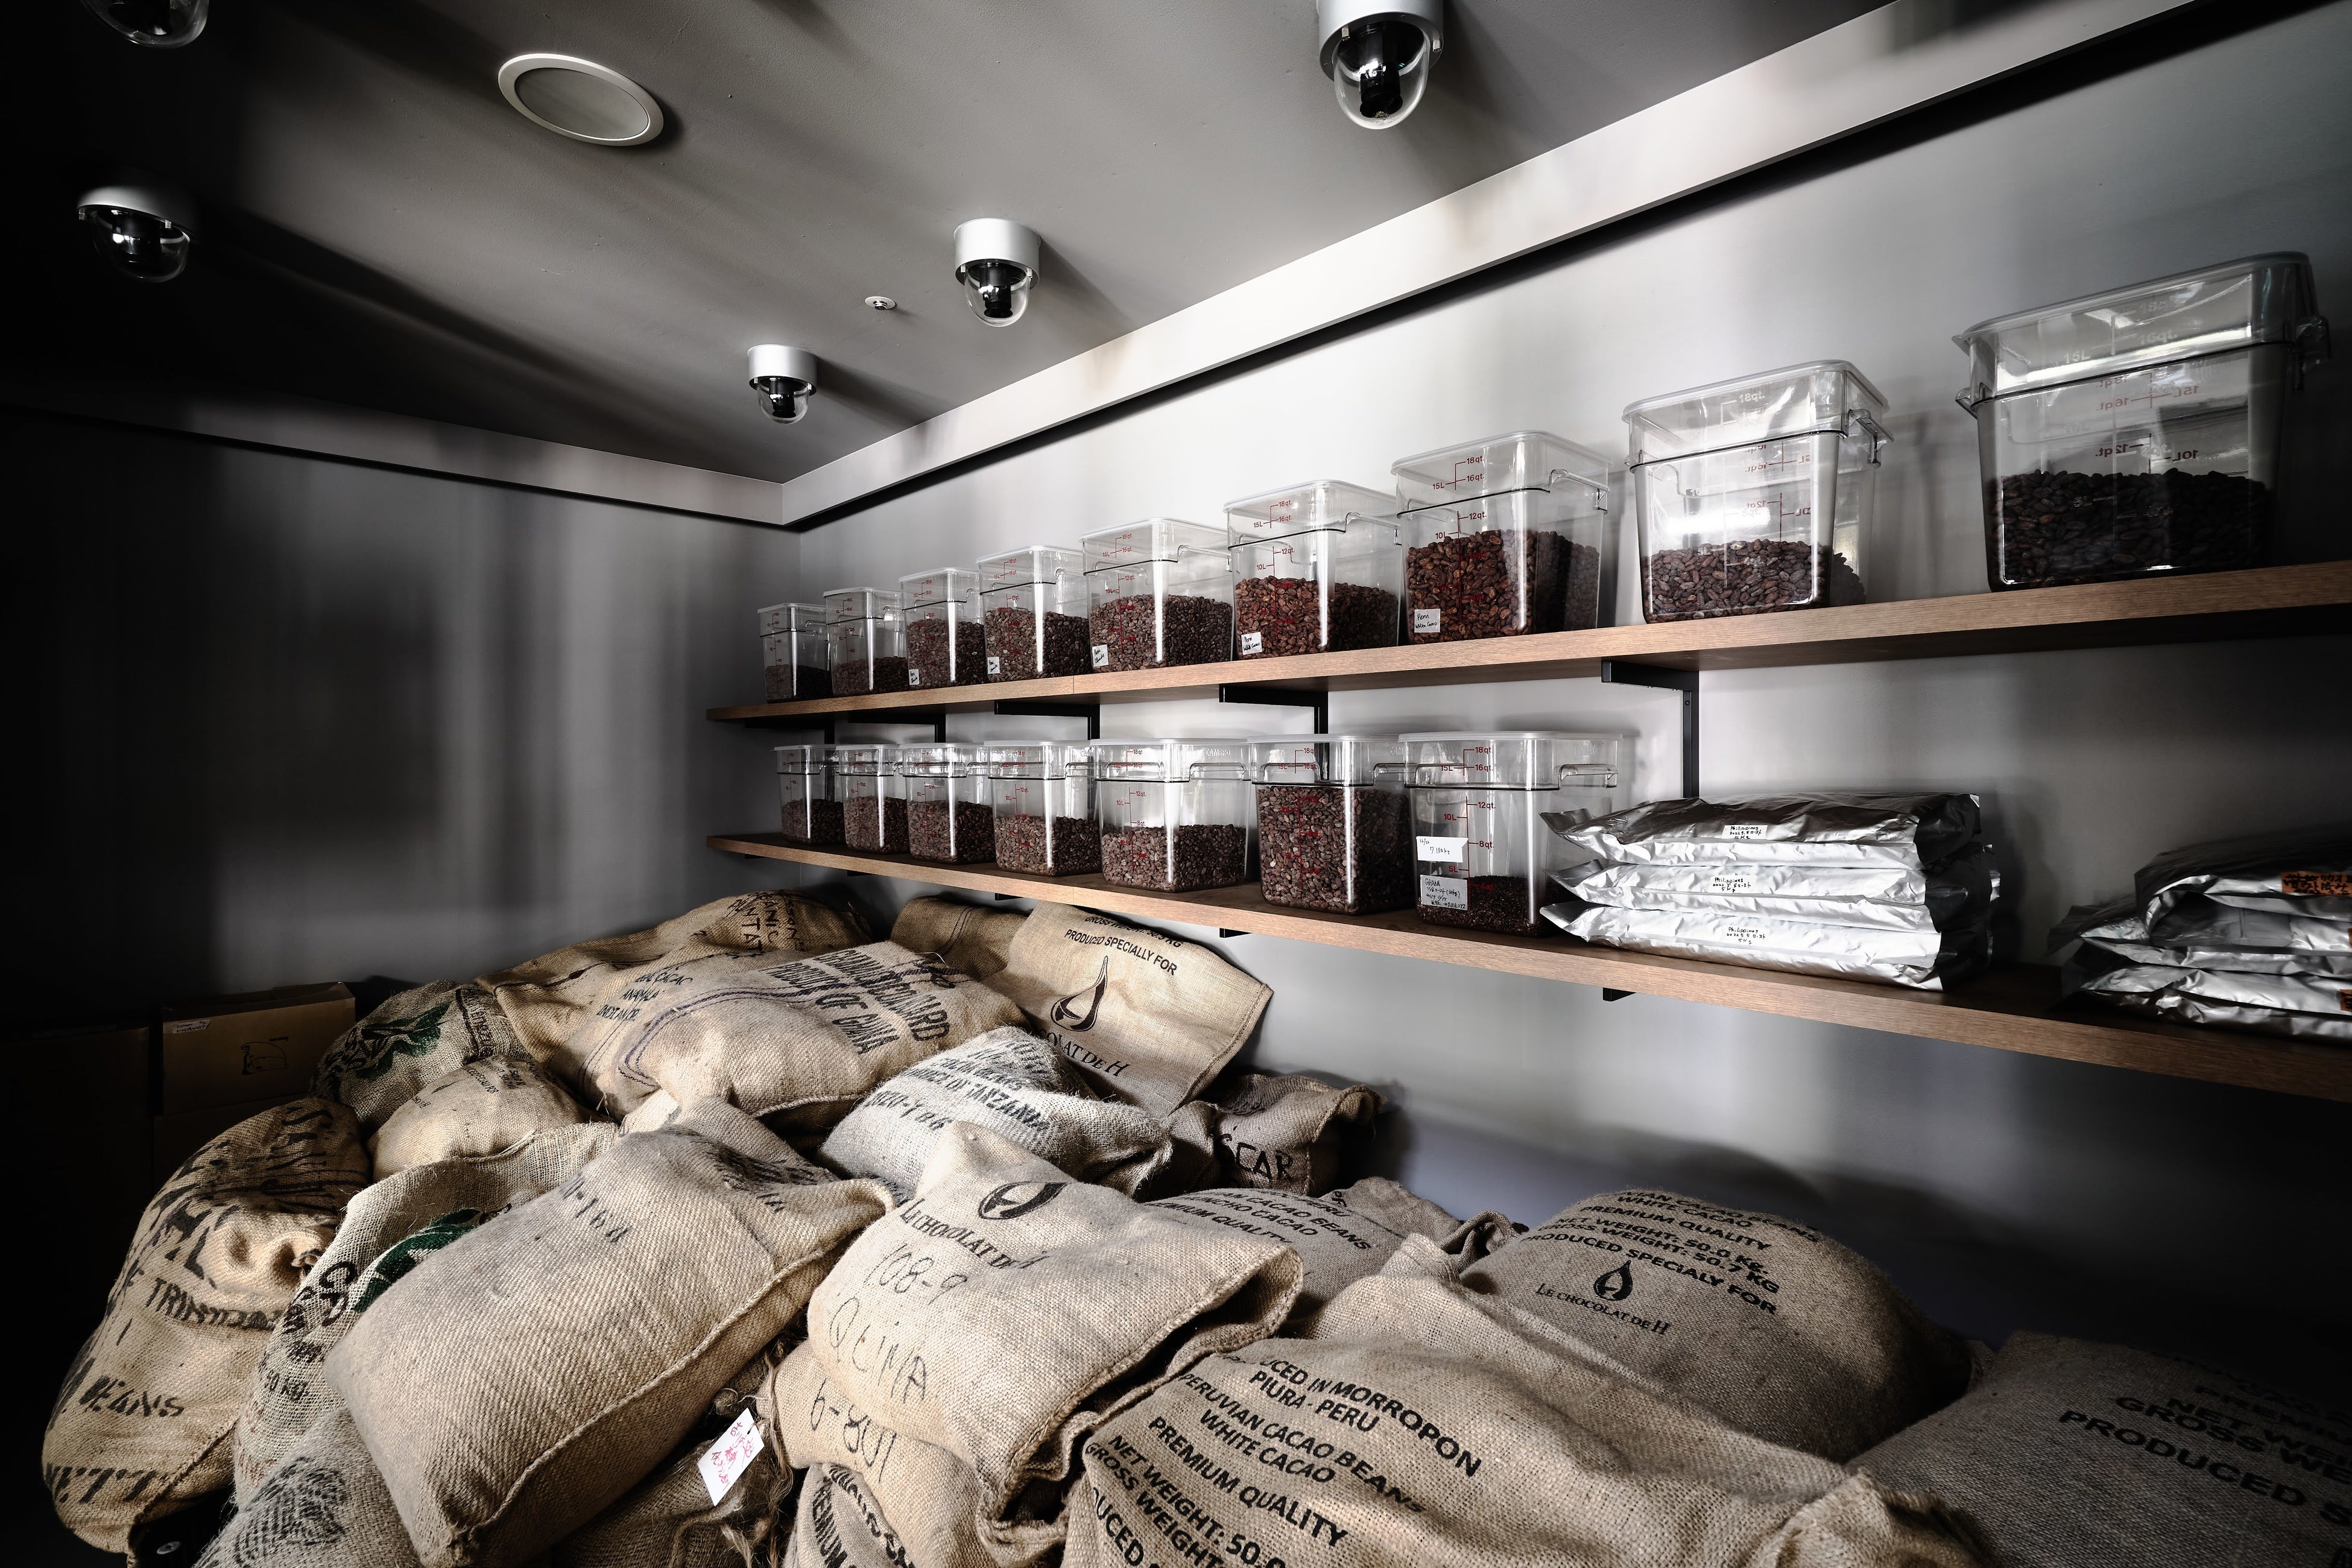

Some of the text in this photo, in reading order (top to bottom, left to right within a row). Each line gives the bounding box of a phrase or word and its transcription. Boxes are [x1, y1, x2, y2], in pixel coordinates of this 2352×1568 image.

[1475, 763, 1494, 772] 16qt.
[1478, 801, 1497, 810] 12qt.
[1479, 840, 1495, 849] 8qt.
[1064, 929, 1178, 976] PRODUCED SPECIALLY FOR
[1104, 1060, 1131, 1077] H
[1246, 1197, 1312, 1218] CACAO
[1309, 1217, 1373, 1251] BEANS
[1250, 1209, 1319, 1236] CACAO
[1580, 1206, 1772, 1251] PREMIUM QUALITY
[1617, 1196, 1754, 1228] WHITE CACAO
[1596, 1217, 1679, 1242] WEIGHT:
[1684, 1239, 1731, 1259] 50.0
[1602, 1227, 1688, 1256] WEIGHT:
[1692, 1252, 1744, 1273] 50.7
[1748, 1271, 1780, 1294] KG
[1521, 1233, 1778, 1314] PRODUCED SPECIALY FOR
[1556, 1292, 1630, 1324] CHOCOLAT
[1649, 1319, 1673, 1335] H
[1177, 1371, 1263, 1433] PERUVIAN
[1261, 1421, 1334, 1459] CACAO
[1249, 1370, 1307, 1411] PIURA
[1319, 1399, 1380, 1434] PERU
[2115, 1397, 2266, 1453] GROSS
[2165, 1398, 2254, 1430] NET
[1200, 1409, 1335, 1484] WHITE CACAO
[1329, 1381, 1482, 1479] MORROPON
[1085, 1442, 1139, 1492] GROSS
[1148, 1415, 1350, 1549] PREMIUM QUALITY
[2058, 1410, 2308, 1506] PRODUCED
[1107, 1434, 1147, 1467] NET
[1143, 1465, 1225, 1545] WEIGHT:
